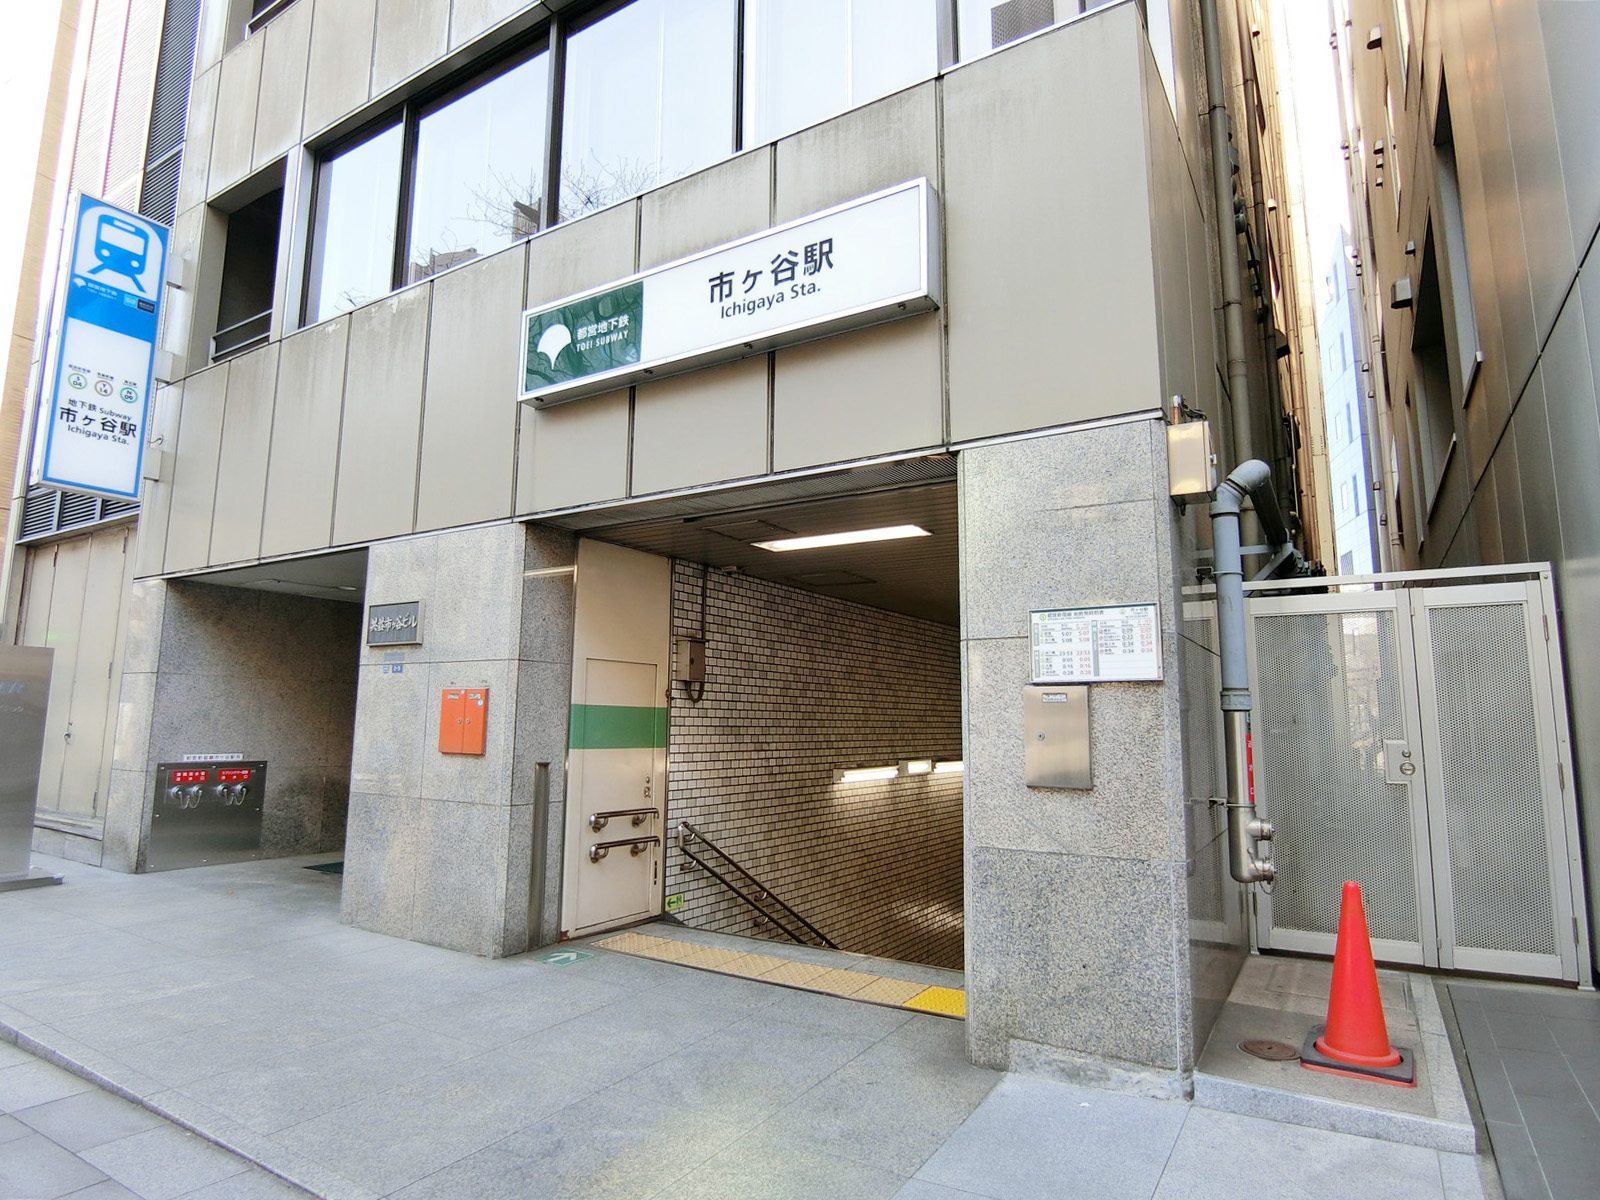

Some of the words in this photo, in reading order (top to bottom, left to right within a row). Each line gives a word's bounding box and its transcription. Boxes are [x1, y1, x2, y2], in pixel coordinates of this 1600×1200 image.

[720, 291, 785, 319] Ichigaya
[790, 282, 821, 300] Sta.
[577, 314, 630, 340] 都営地下鉄
[576, 341, 593, 352] TOEI
[595, 330, 629, 347] SUBWAY
[68, 398, 97, 412] 地下鉄
[99, 407, 132, 422] Subway
[67, 425, 109, 440] Ichigaya
[112, 434, 129, 445] Sta.
